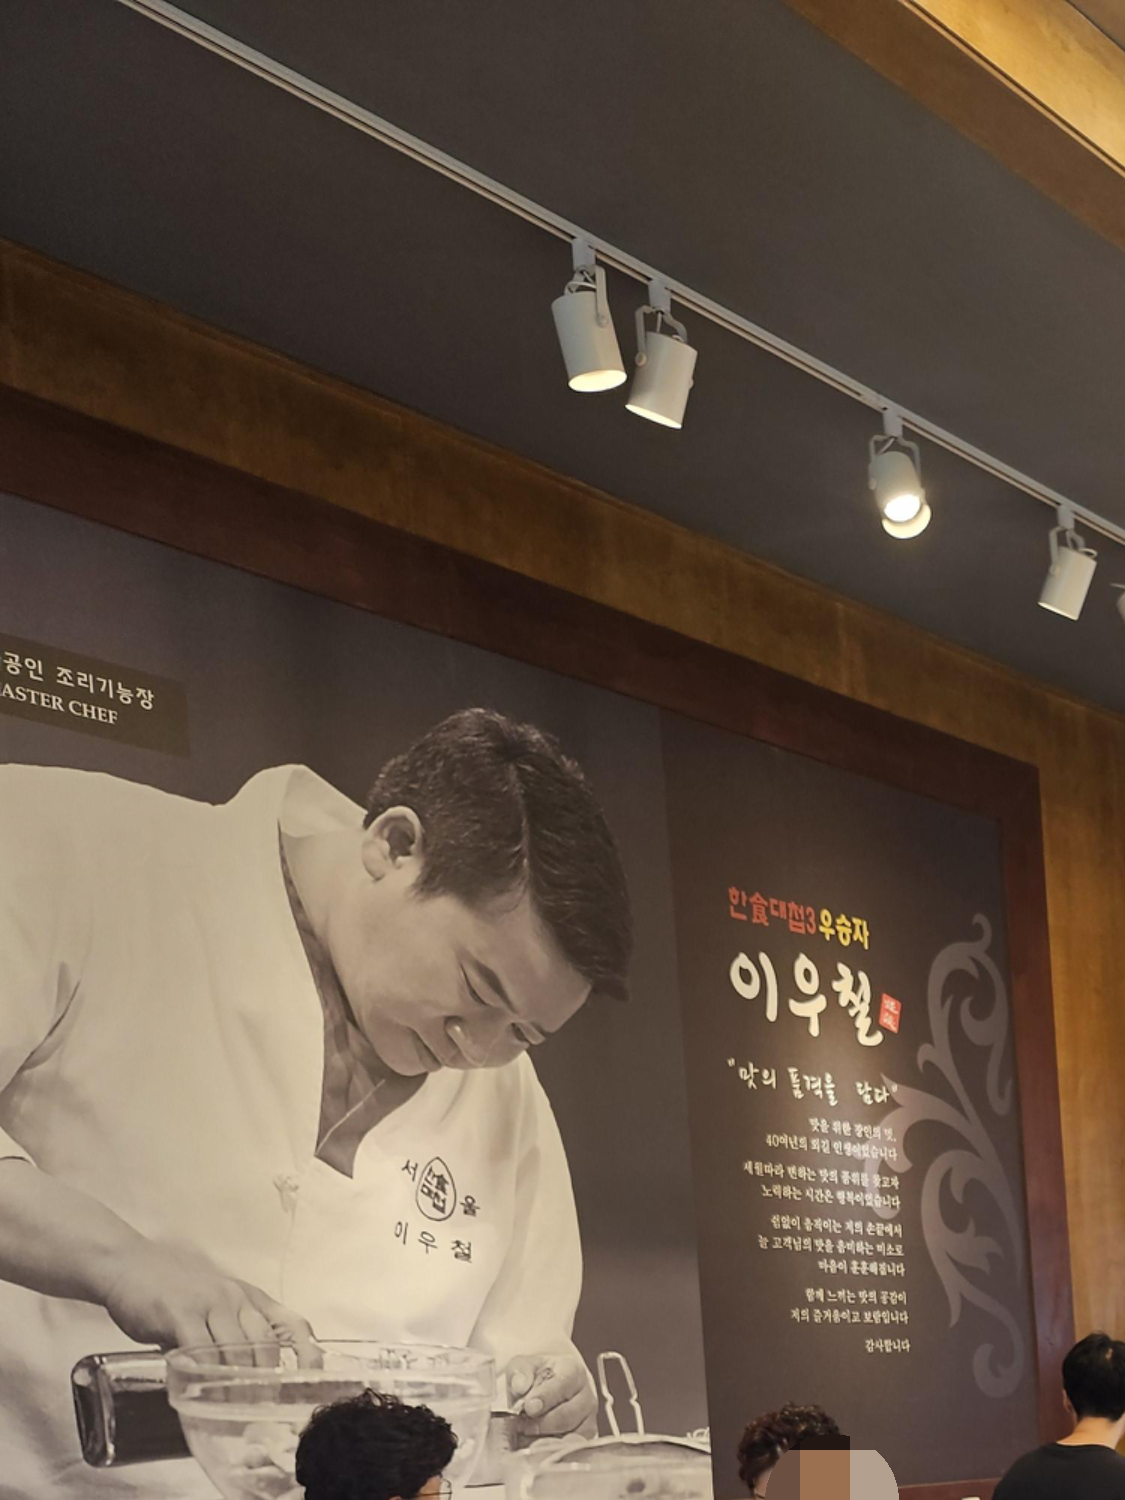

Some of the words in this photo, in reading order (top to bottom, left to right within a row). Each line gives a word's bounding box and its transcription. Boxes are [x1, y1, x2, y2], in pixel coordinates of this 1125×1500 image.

[0, 651, 44, 682] 공인
[56, 666, 155, 710] 조리기능장
[0, 683, 65, 712] ASTER
[68, 700, 118, 725] CHEF
[818, 908, 870, 950] 우승자
[729, 951, 884, 1046] 이우철
[787, 1067, 838, 1106] 품격을
[765, 1133, 808, 1151] 40여년의
[854, 1123, 882, 1141] 장인의
[818, 1167, 839, 1185] 맛의
[761, 1183, 802, 1201] 노력하는
[805, 1187, 834, 1203] 시간은
[803, 1217, 843, 1234] 움직이는
[845, 1219, 864, 1235] 저의
[865, 1221, 903, 1238] 손끝에서
[771, 1236, 812, 1252] 고객님의
[813, 1238, 834, 1254] 맛을
[836, 1240, 875, 1256] 음미하는
[876, 1241, 905, 1257] 미소로
[818, 1258, 848, 1274] 마음이
[805, 1287, 825, 1303] 함께
[858, 1289, 878, 1305] 맛의
[790, 1308, 810, 1324] 저의
[812, 1309, 861, 1324] 즐거움이고
[863, 1310, 909, 1325] 보람입니다
[865, 1338, 911, 1353] 감사합니다
